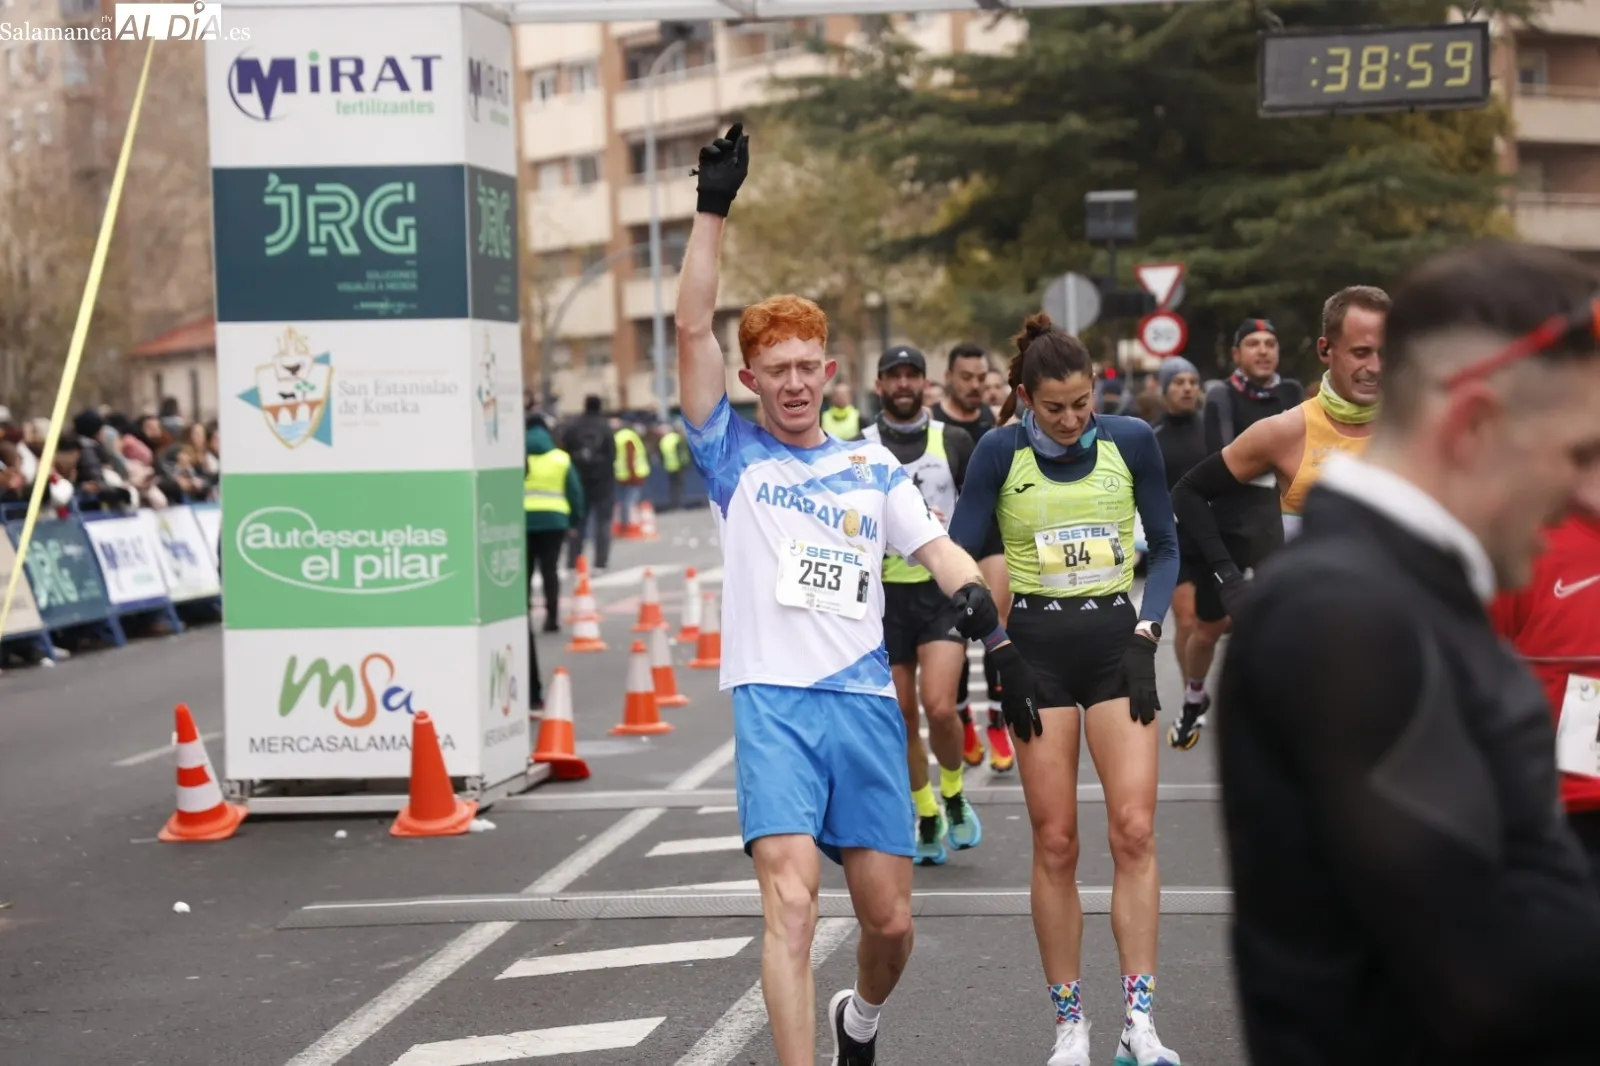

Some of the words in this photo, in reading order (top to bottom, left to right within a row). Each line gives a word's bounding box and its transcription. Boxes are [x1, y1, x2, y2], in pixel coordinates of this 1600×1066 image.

[336, 99, 435, 115] fertilizantes
[263, 173, 417, 257] JRG
[338, 380, 369, 396] San
[374, 379, 459, 396] Estanislao
[338, 399, 358, 414] de
[363, 398, 421, 414] Kostka
[244, 522, 448, 549] autoescuelas
[1058, 528, 1110, 541] SETEL
[806, 546, 863, 567] SETEL
[1063, 541, 1091, 568] 84
[301, 549, 340, 582] el
[354, 549, 448, 589] pilar
[798, 559, 843, 592] 253
[248, 734, 457, 752] MERCASALAMAA
